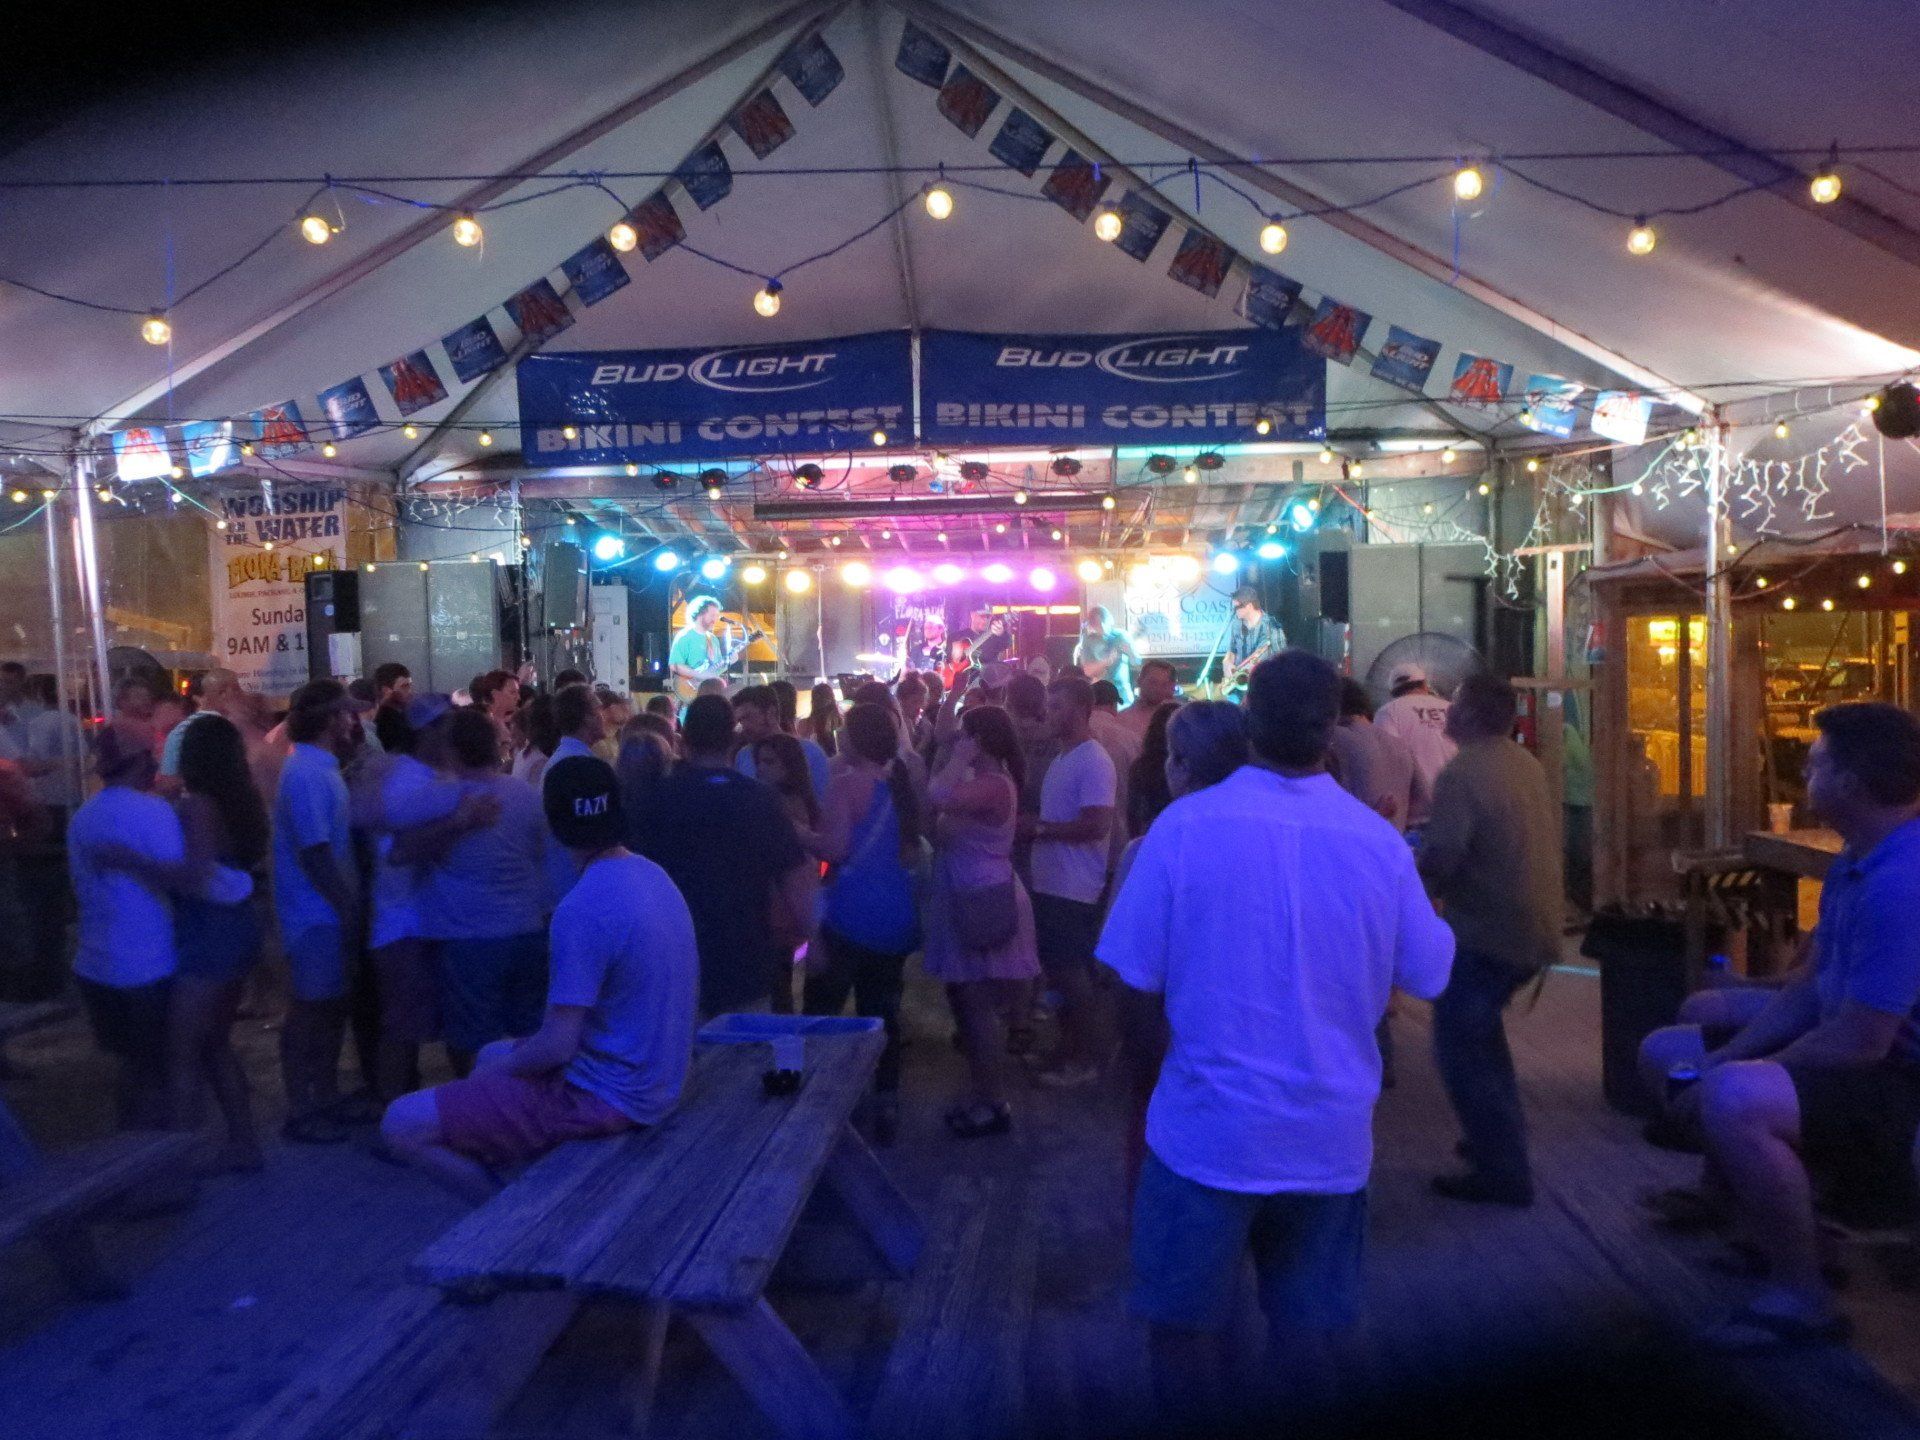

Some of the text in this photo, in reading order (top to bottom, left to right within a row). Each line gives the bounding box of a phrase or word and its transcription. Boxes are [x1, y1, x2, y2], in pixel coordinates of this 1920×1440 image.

[995, 345, 1249, 368] BUD LIGHT
[591, 353, 837, 385] BUD LIGHT
[936, 402, 1313, 429] BIKINI CONTEST
[536, 405, 903, 452] BIKINI CONTEST
[255, 514, 340, 542] WATER
[251, 604, 305, 626] Sunda
[1187, 614, 1226, 625] RENTA
[227, 632, 305, 655] 9AM & 1
[574, 792, 609, 816] EAZY
